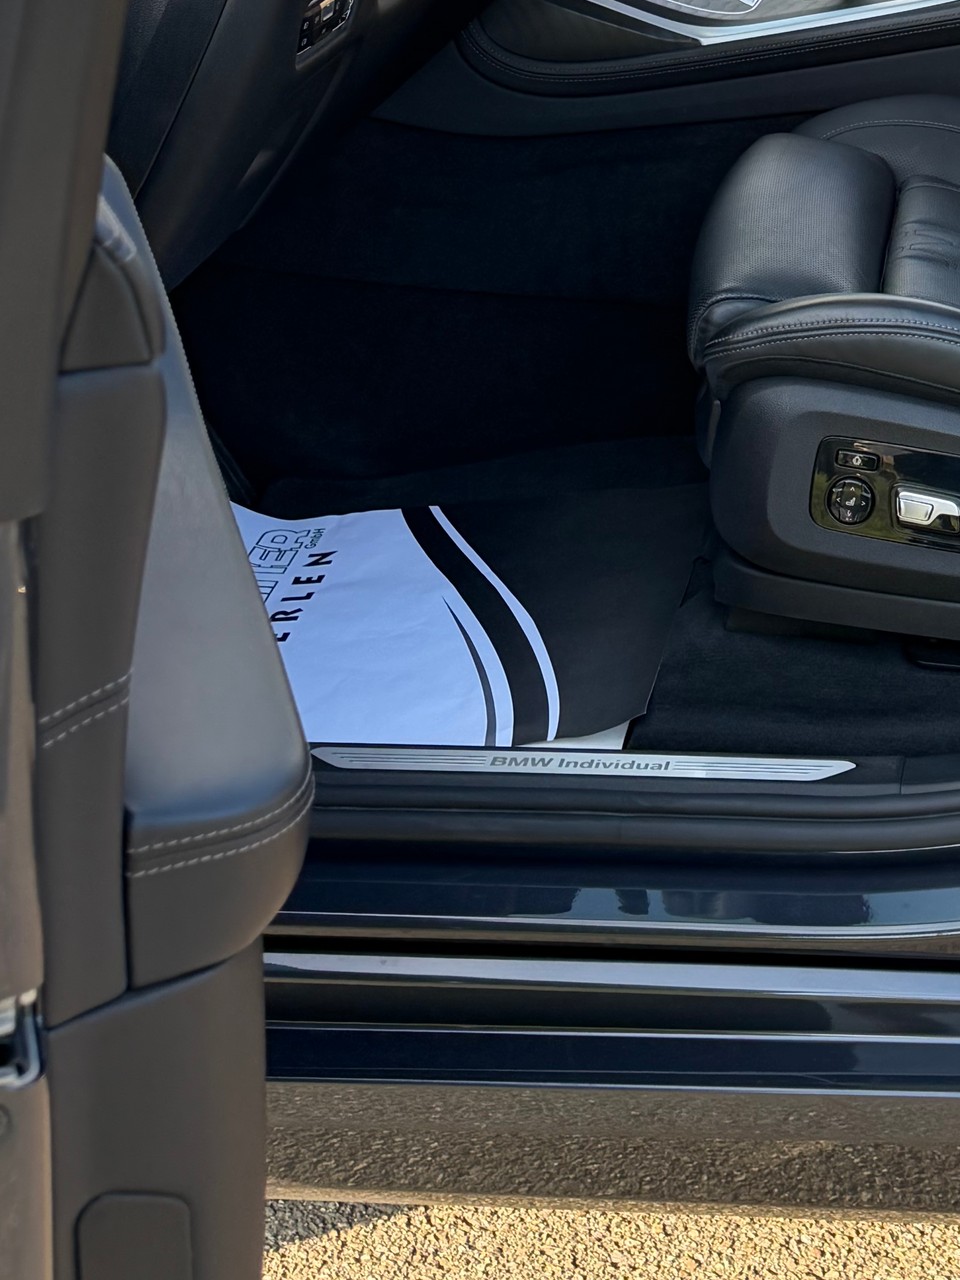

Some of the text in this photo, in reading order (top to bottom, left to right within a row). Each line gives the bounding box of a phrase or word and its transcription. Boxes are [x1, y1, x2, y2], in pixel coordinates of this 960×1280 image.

[304, 528, 326, 549] GmbH
[490, 756, 670, 771] BMW Individual
